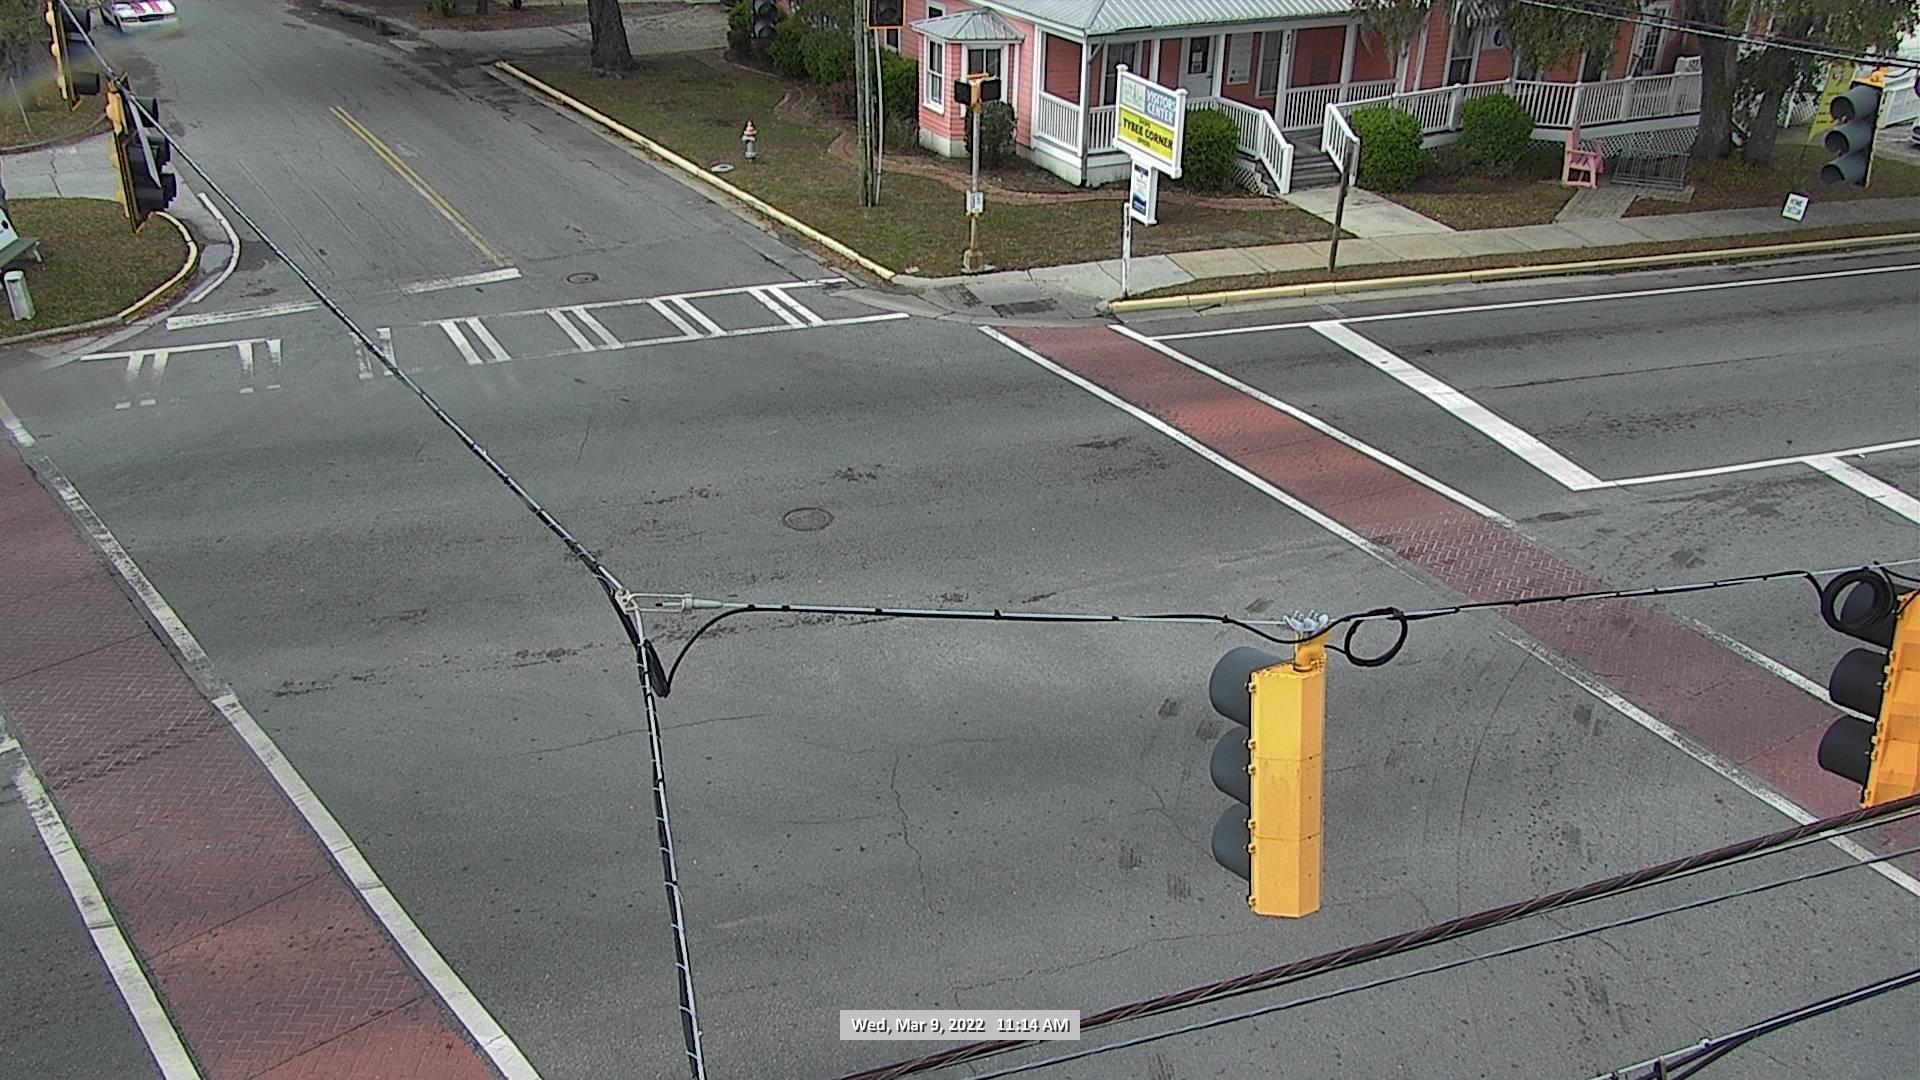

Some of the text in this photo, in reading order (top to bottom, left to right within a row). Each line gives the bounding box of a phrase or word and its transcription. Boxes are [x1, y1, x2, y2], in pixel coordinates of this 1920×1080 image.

[1147, 89, 1176, 111] VISITORS
[1147, 104, 1172, 122] CENTER
[1123, 118, 1143, 136] TYBEE
[1145, 129, 1173, 149] CORNER
